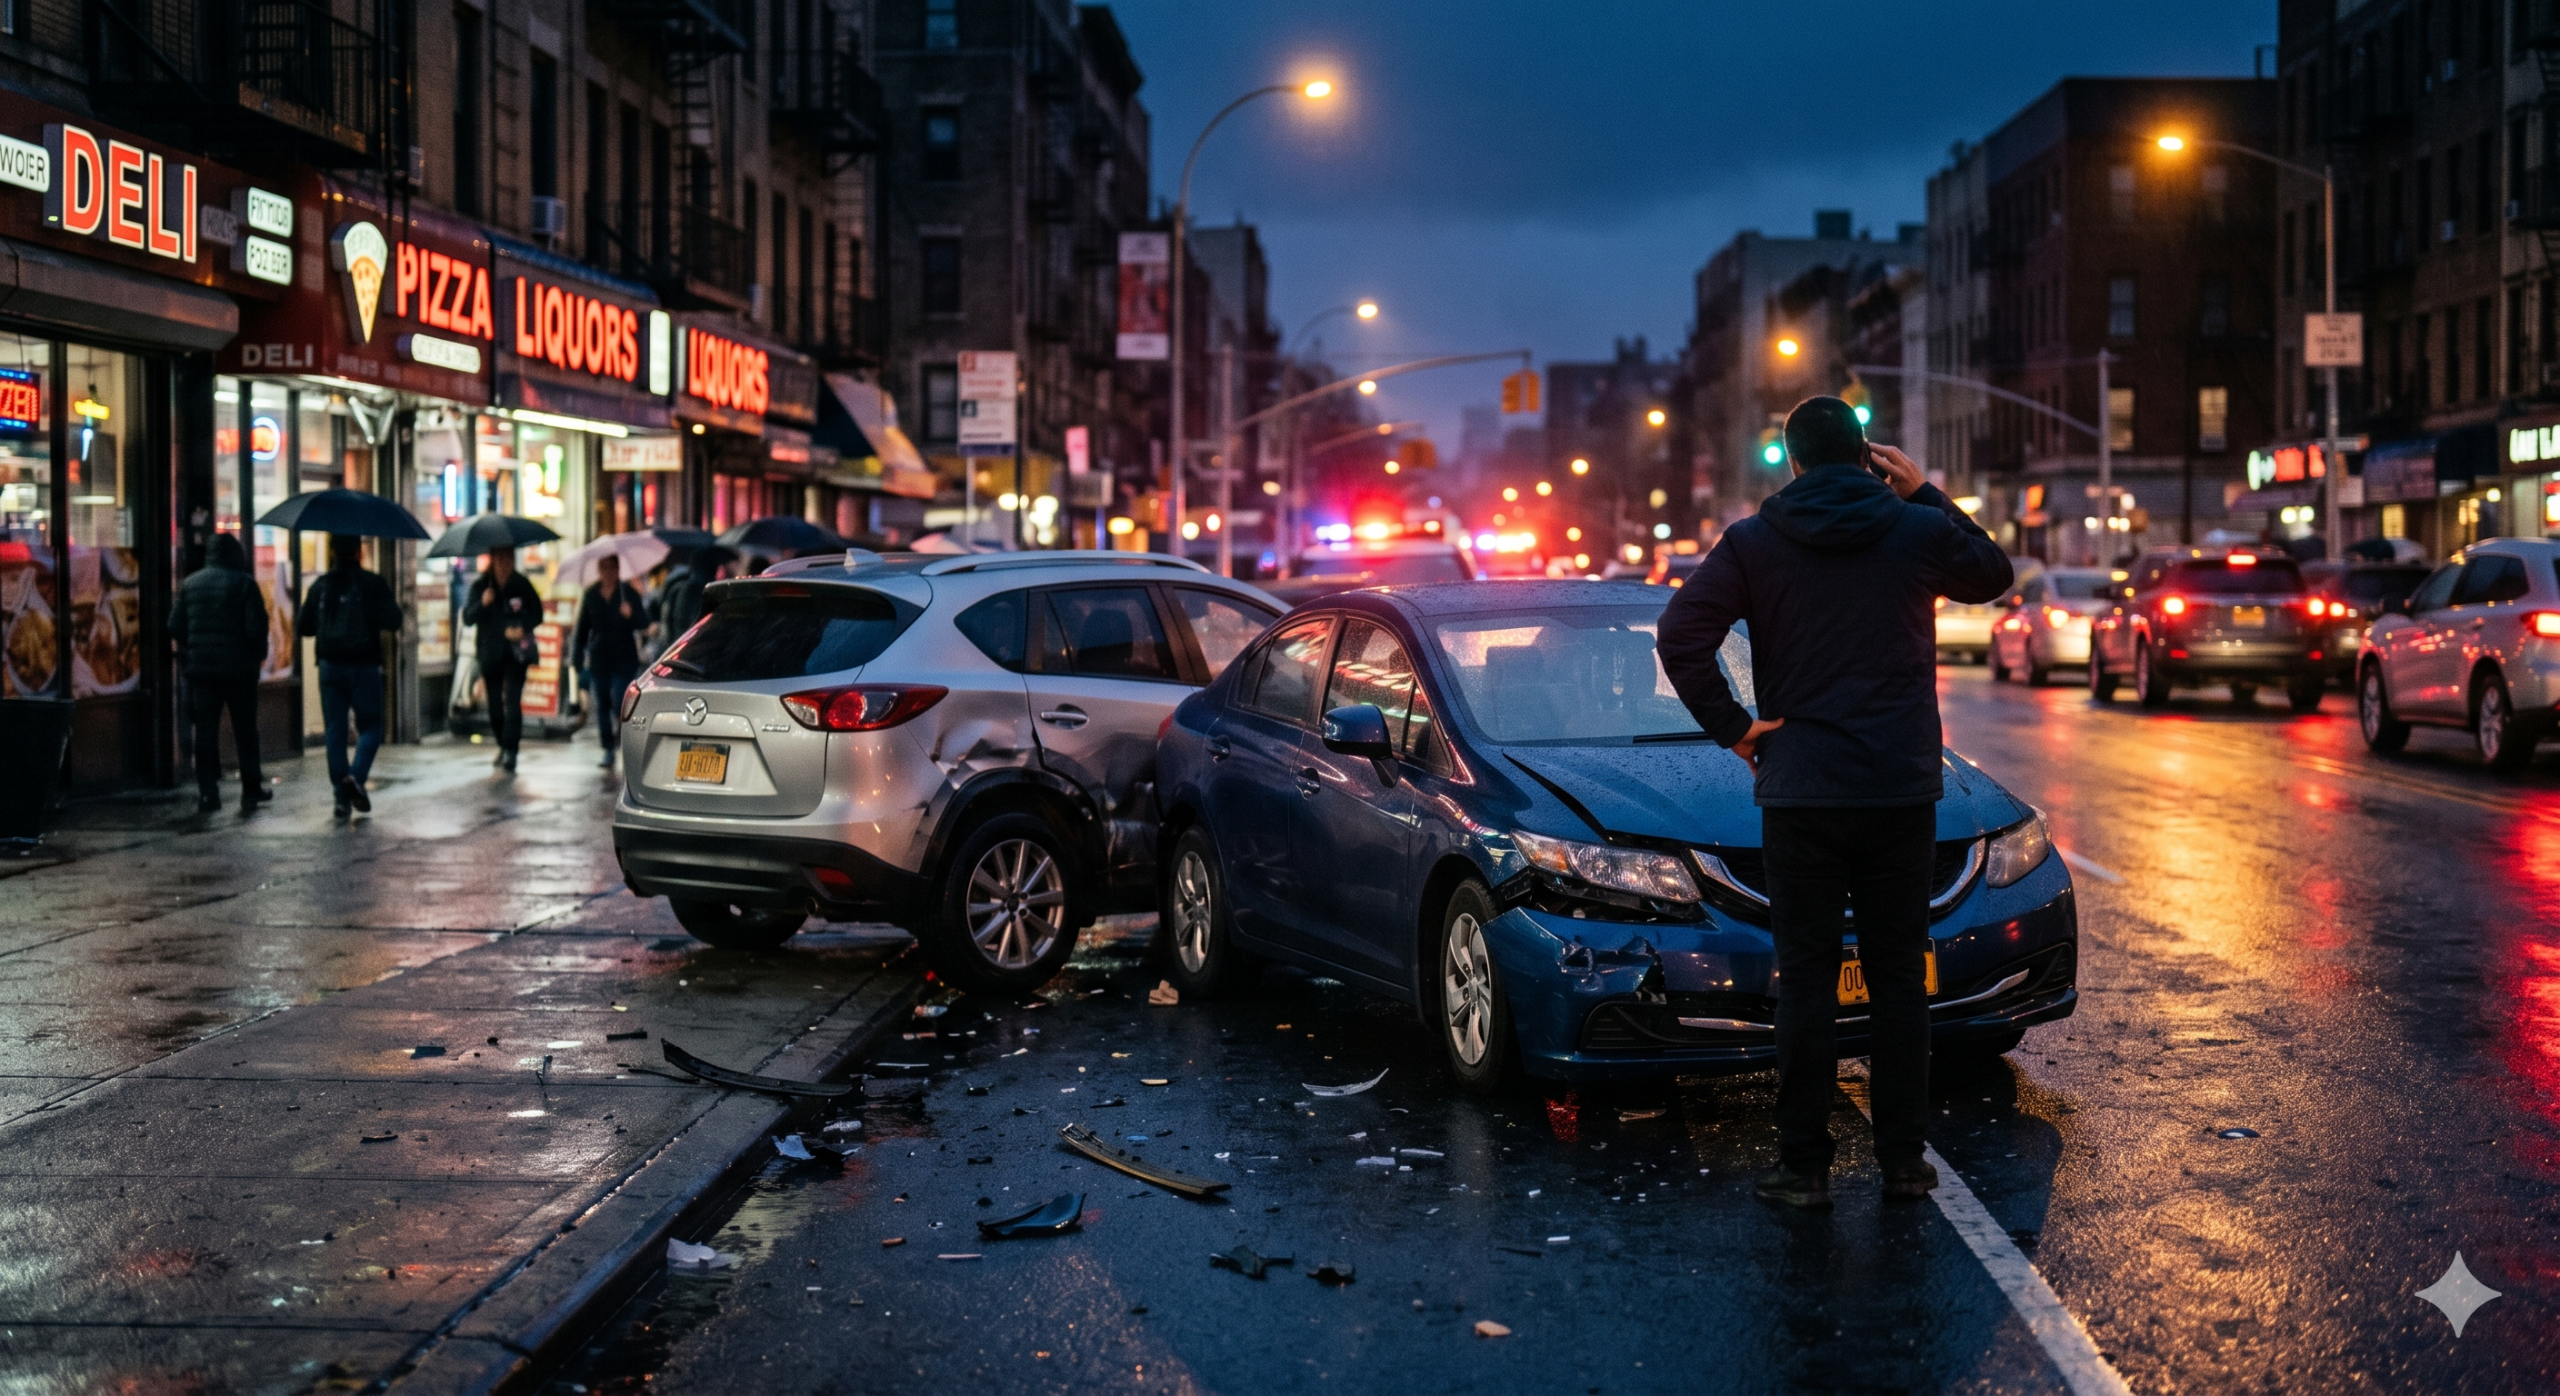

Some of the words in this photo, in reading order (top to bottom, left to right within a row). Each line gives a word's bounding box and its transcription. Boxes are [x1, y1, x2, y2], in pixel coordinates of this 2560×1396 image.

[63, 123, 197, 264] DELI
[396, 240, 494, 341] PIZZA
[515, 275, 639, 383] LIQUORS
[242, 343, 314, 368] DELI
[689, 327, 769, 416] LIQUORS
